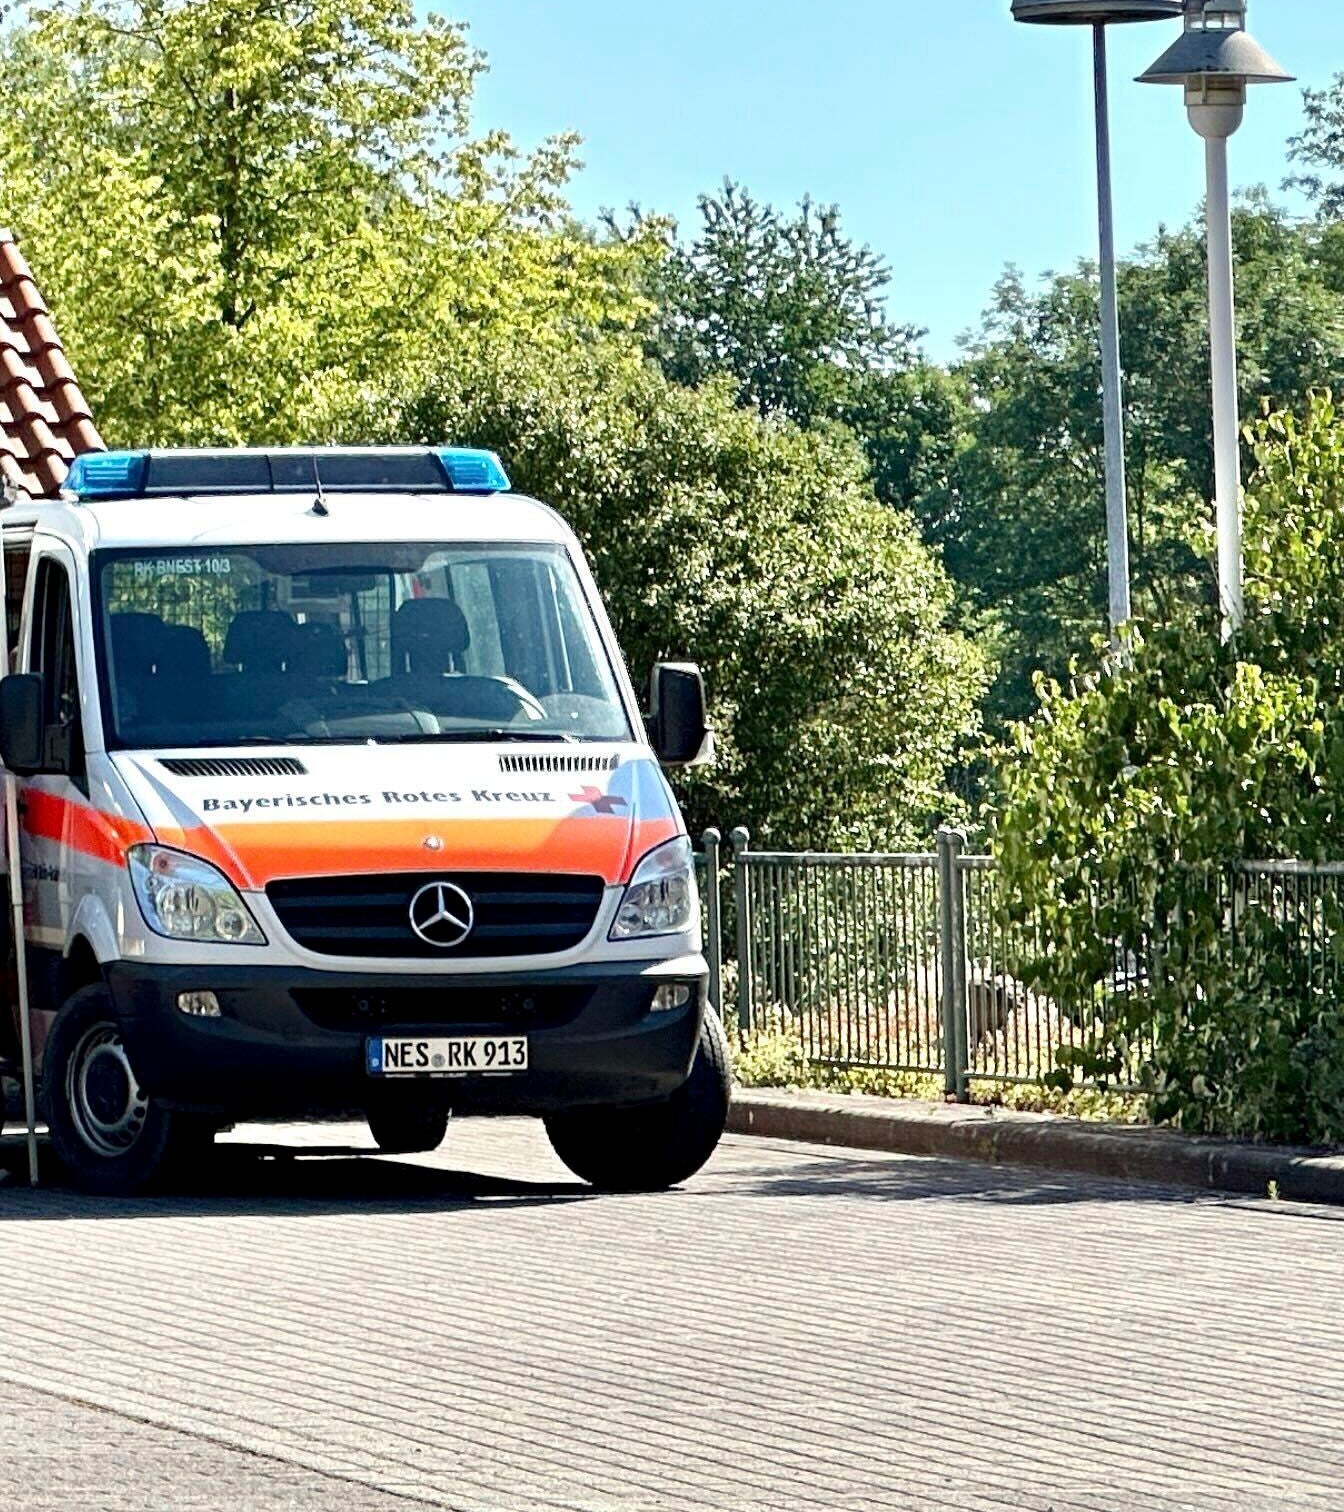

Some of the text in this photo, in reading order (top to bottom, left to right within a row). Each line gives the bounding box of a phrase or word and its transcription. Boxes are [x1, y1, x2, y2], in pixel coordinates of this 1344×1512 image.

[203, 789, 556, 813] Bayerisches Rotes Kreuz
[384, 1040, 526, 1068] NES RK 913
